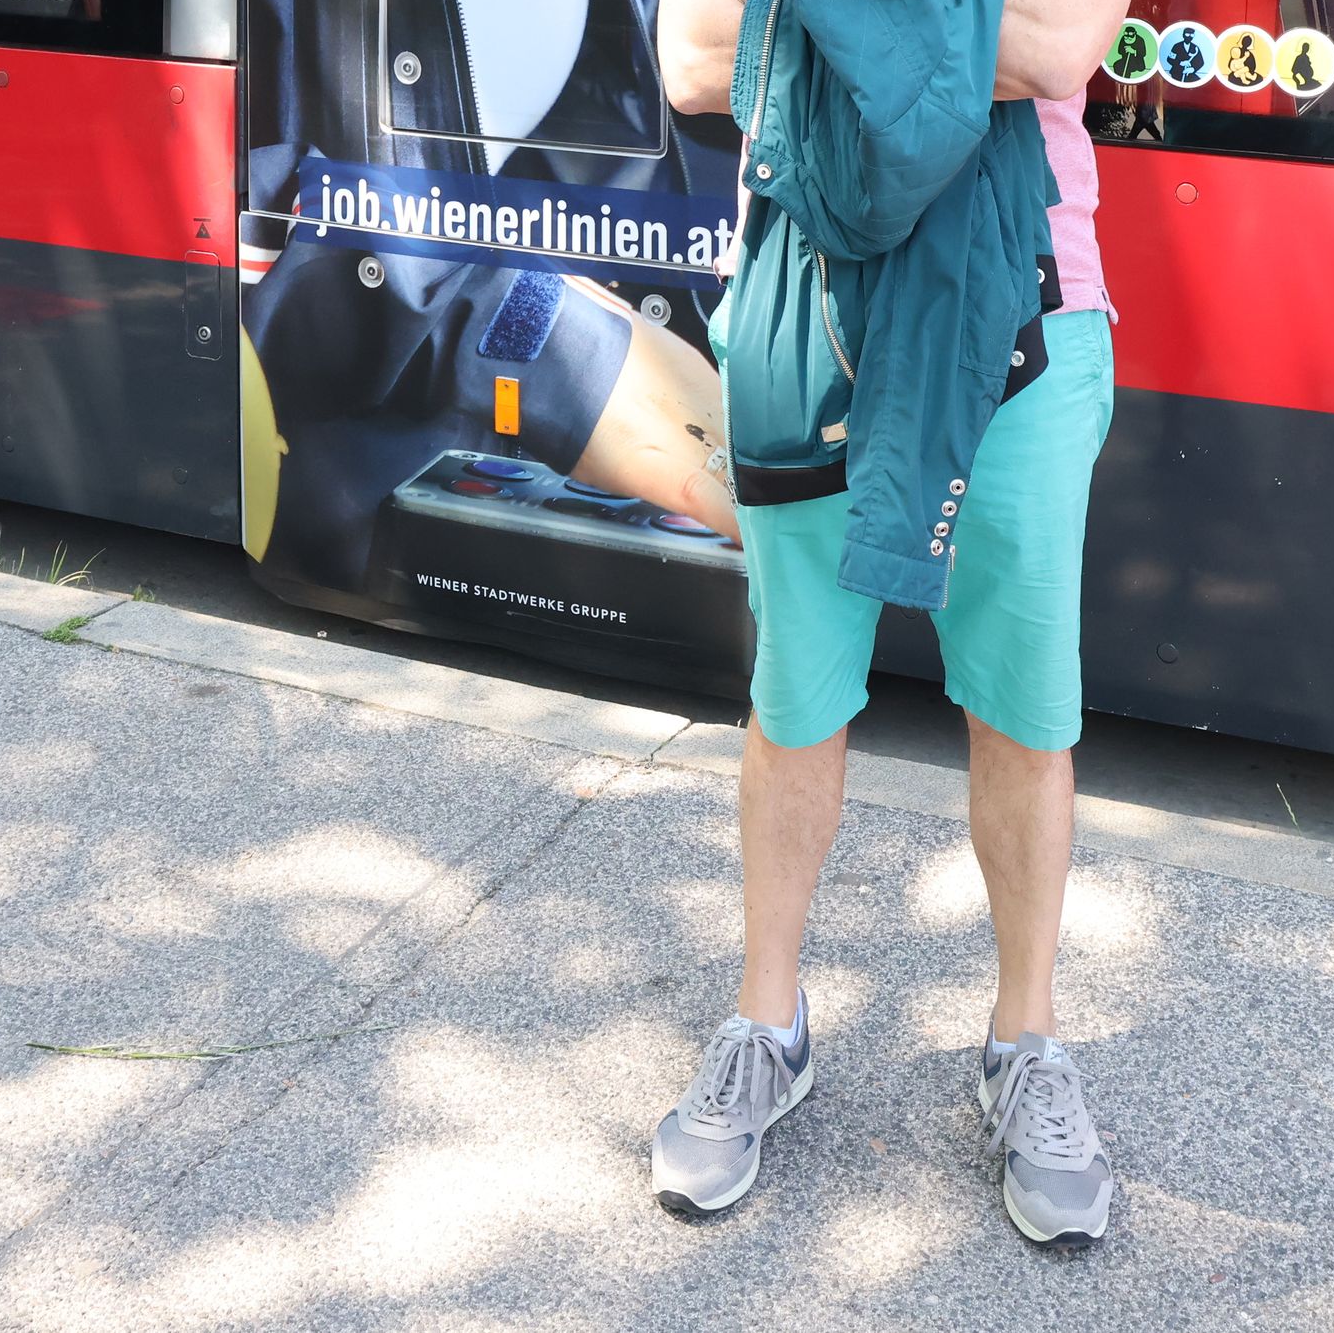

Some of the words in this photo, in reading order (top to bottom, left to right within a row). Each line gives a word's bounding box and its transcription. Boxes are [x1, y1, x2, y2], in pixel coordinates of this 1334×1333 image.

[316, 174, 733, 268] job.wienerlinien.at
[417, 573, 468, 594] WIENER
[473, 585, 565, 612] STADTWERKE
[570, 603, 627, 624] GRUPPE
